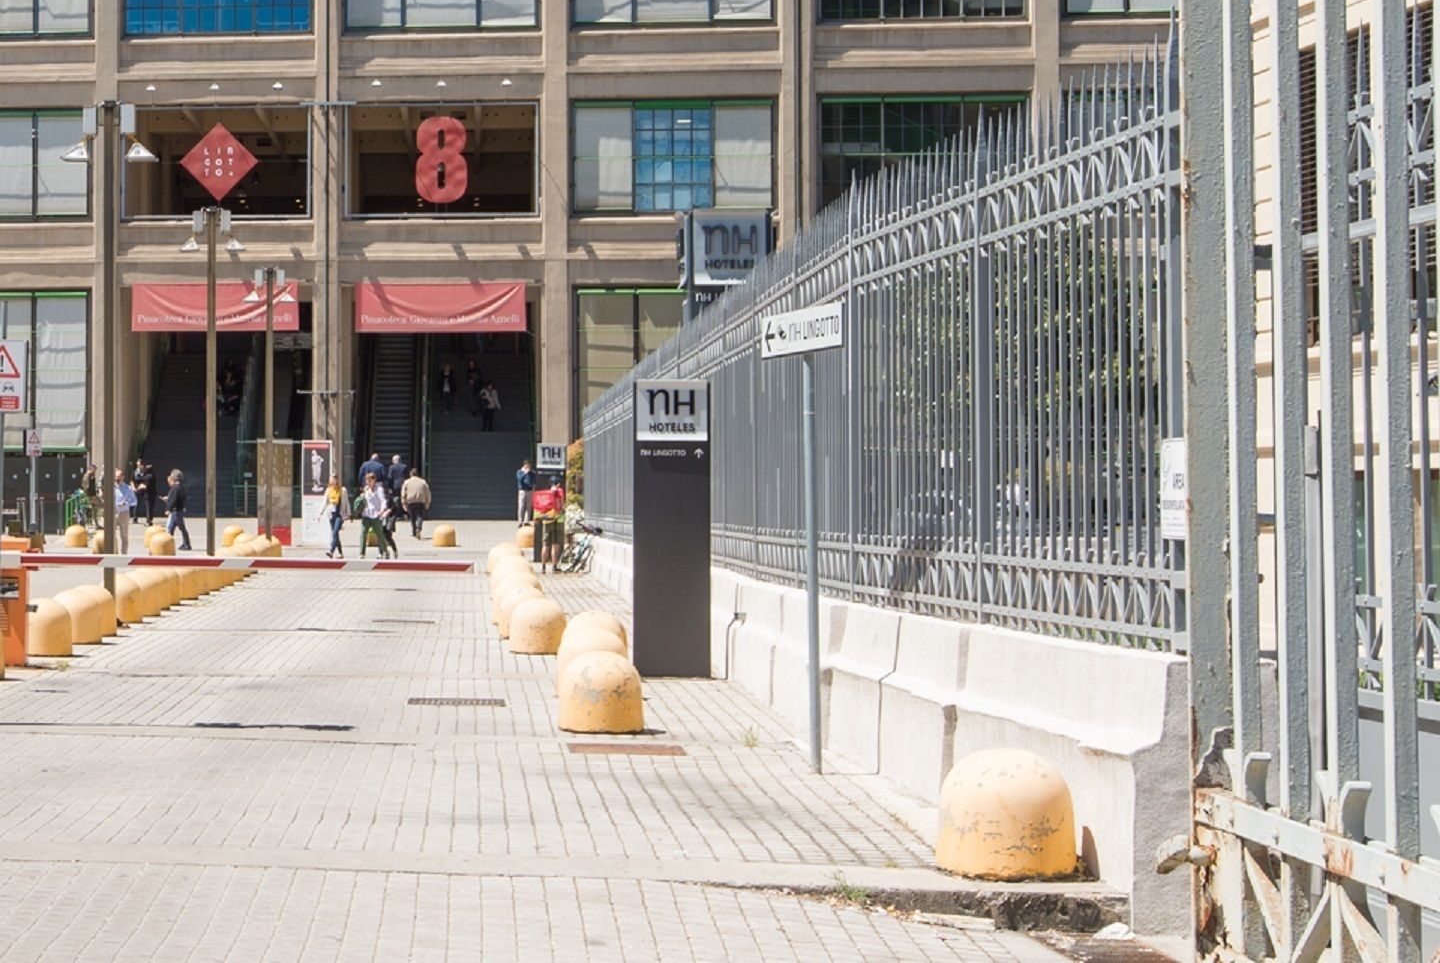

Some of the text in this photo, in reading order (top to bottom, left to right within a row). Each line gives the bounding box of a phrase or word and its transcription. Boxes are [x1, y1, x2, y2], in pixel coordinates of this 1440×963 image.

[416, 116, 468, 203] 8
[361, 314, 407, 324] Pinacoteca
[649, 422, 696, 433] HOTELES
[653, 448, 687, 456] LINGOTTO
